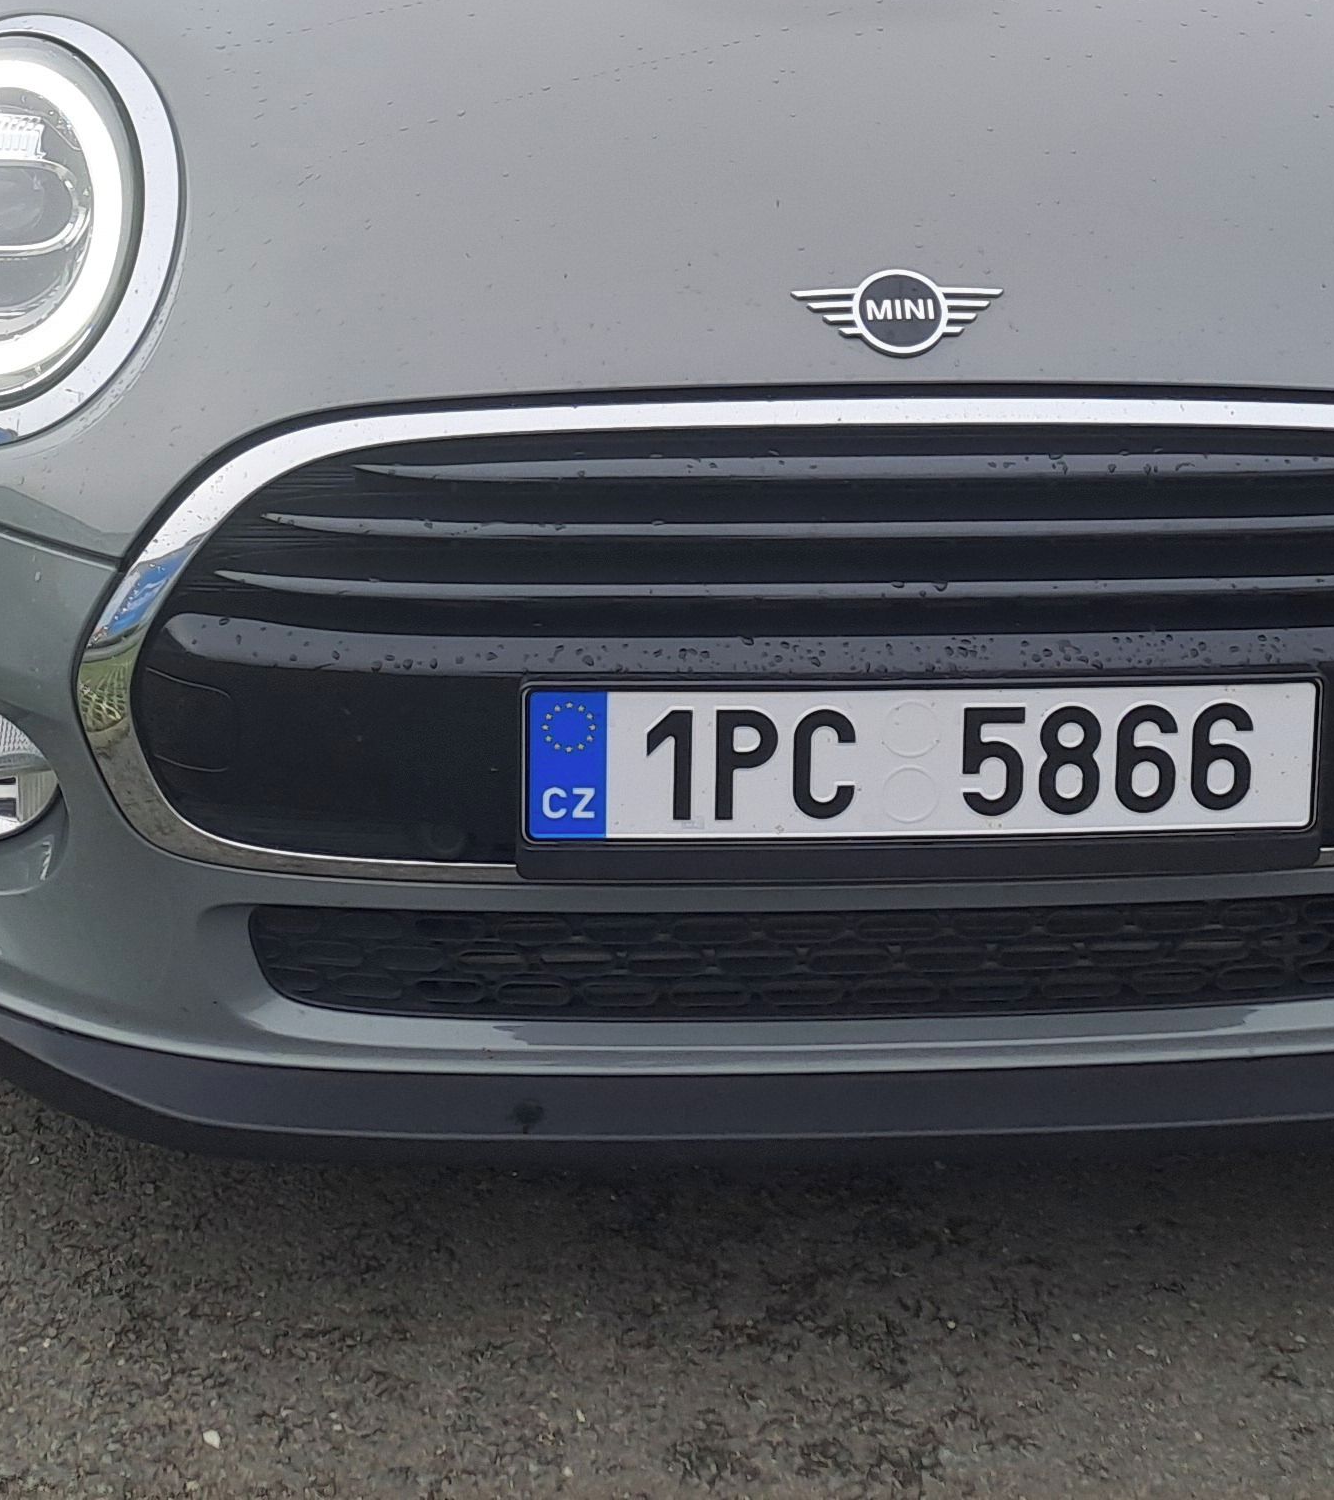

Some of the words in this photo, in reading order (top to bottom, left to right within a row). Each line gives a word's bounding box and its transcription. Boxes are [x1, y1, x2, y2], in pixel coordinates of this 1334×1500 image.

[866, 298, 935, 320] MINI
[646, 709, 857, 821] 1PC
[962, 702, 1254, 817] 5866
[542, 787, 596, 819] CZ
